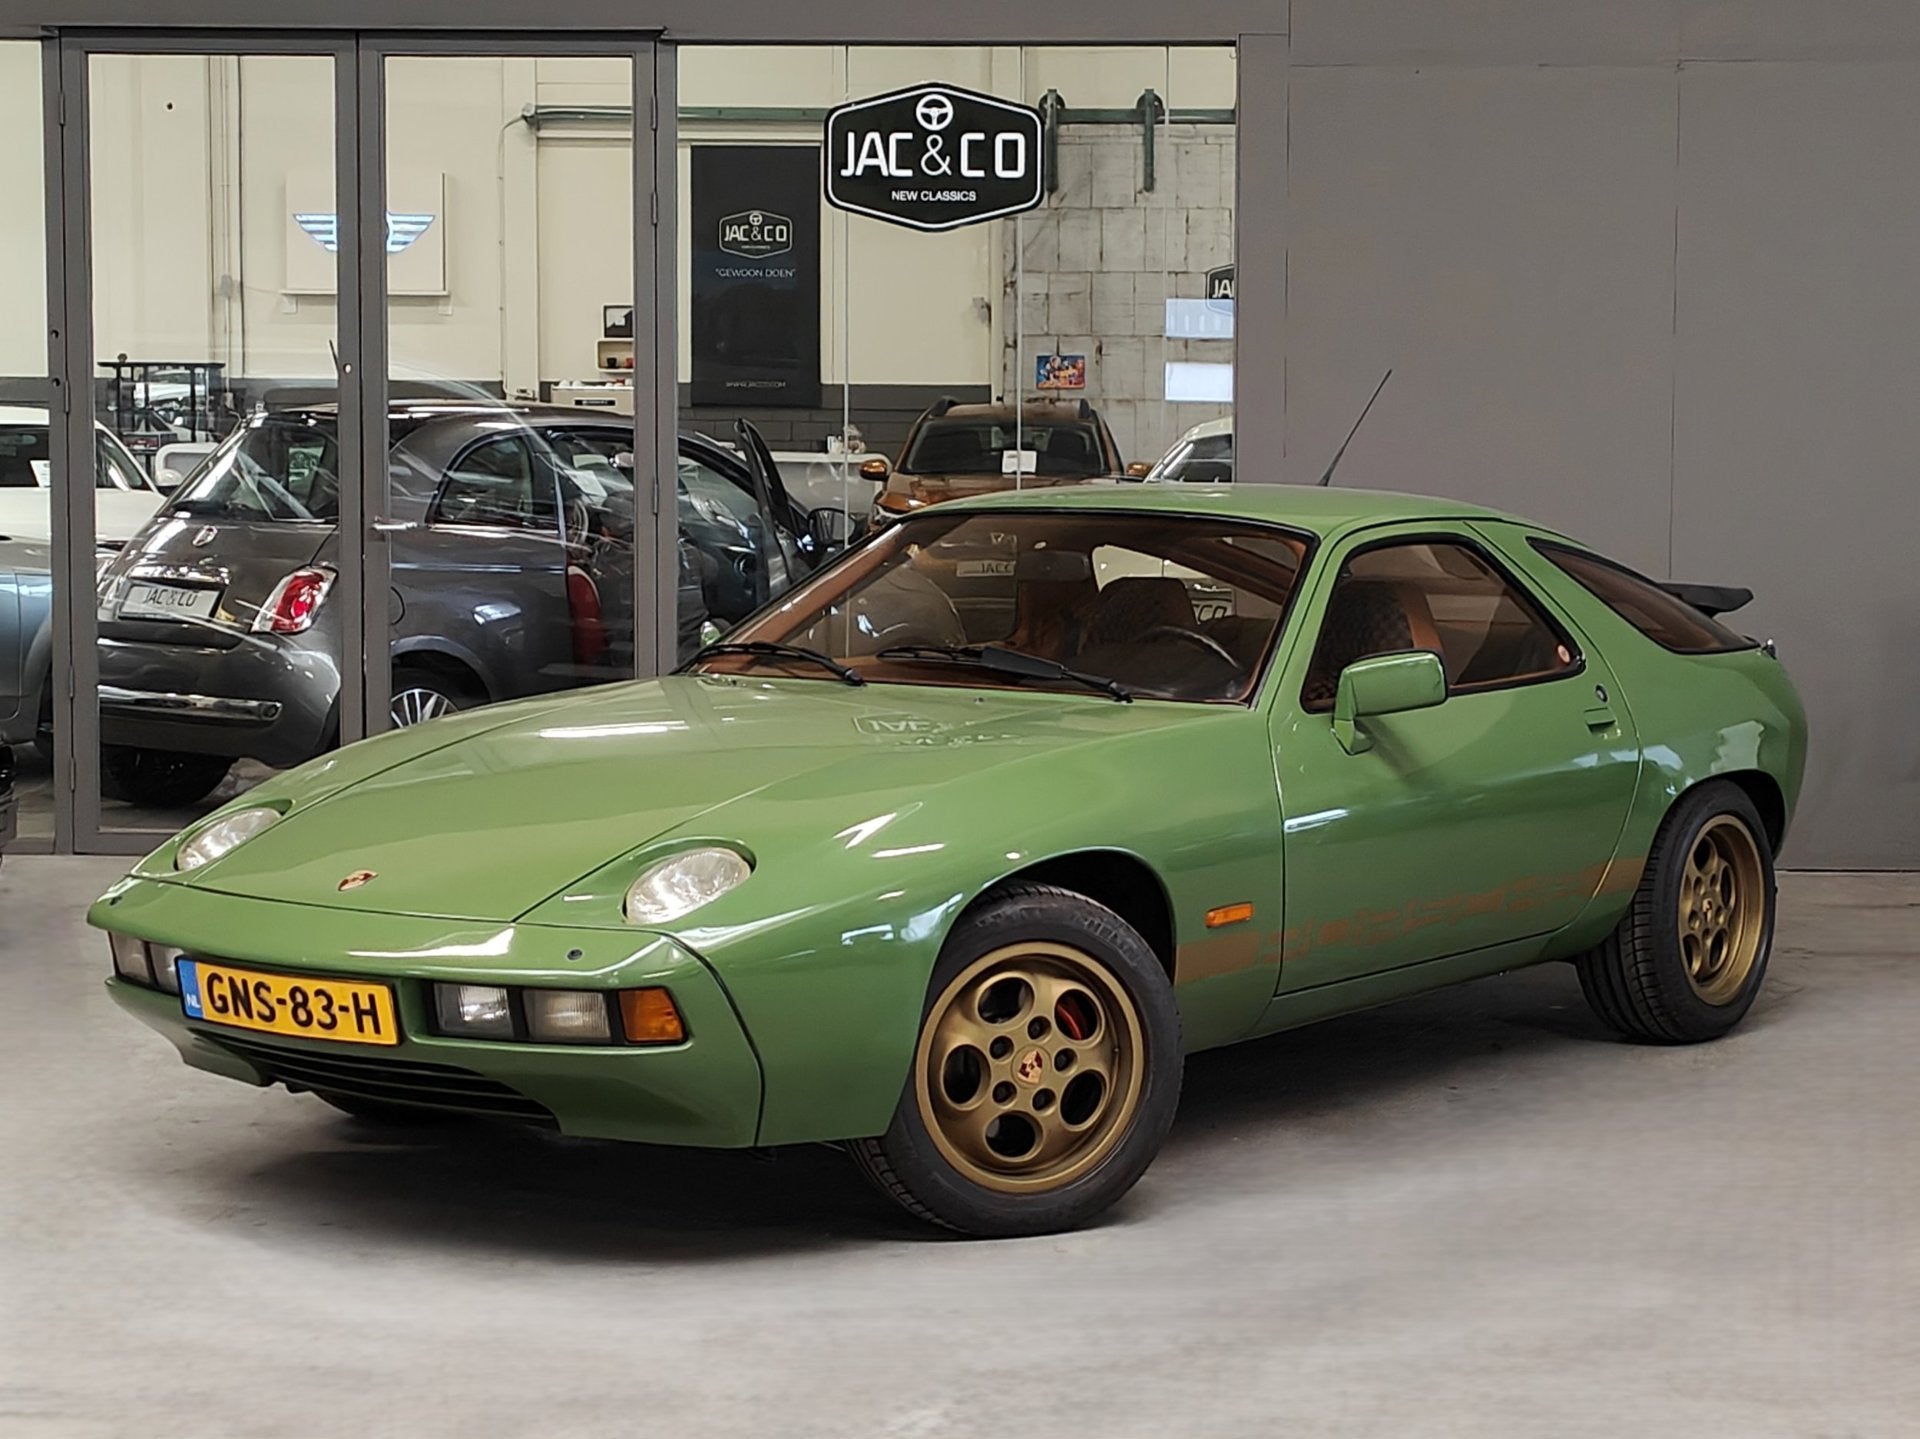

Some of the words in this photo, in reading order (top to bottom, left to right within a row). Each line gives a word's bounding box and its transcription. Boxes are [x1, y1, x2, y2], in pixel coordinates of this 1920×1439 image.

[891, 190, 918, 201] NEW
[920, 190, 977, 202] CLASSICS
[186, 993, 201, 1009] NL
[206, 972, 382, 1036] GNS-83-H
